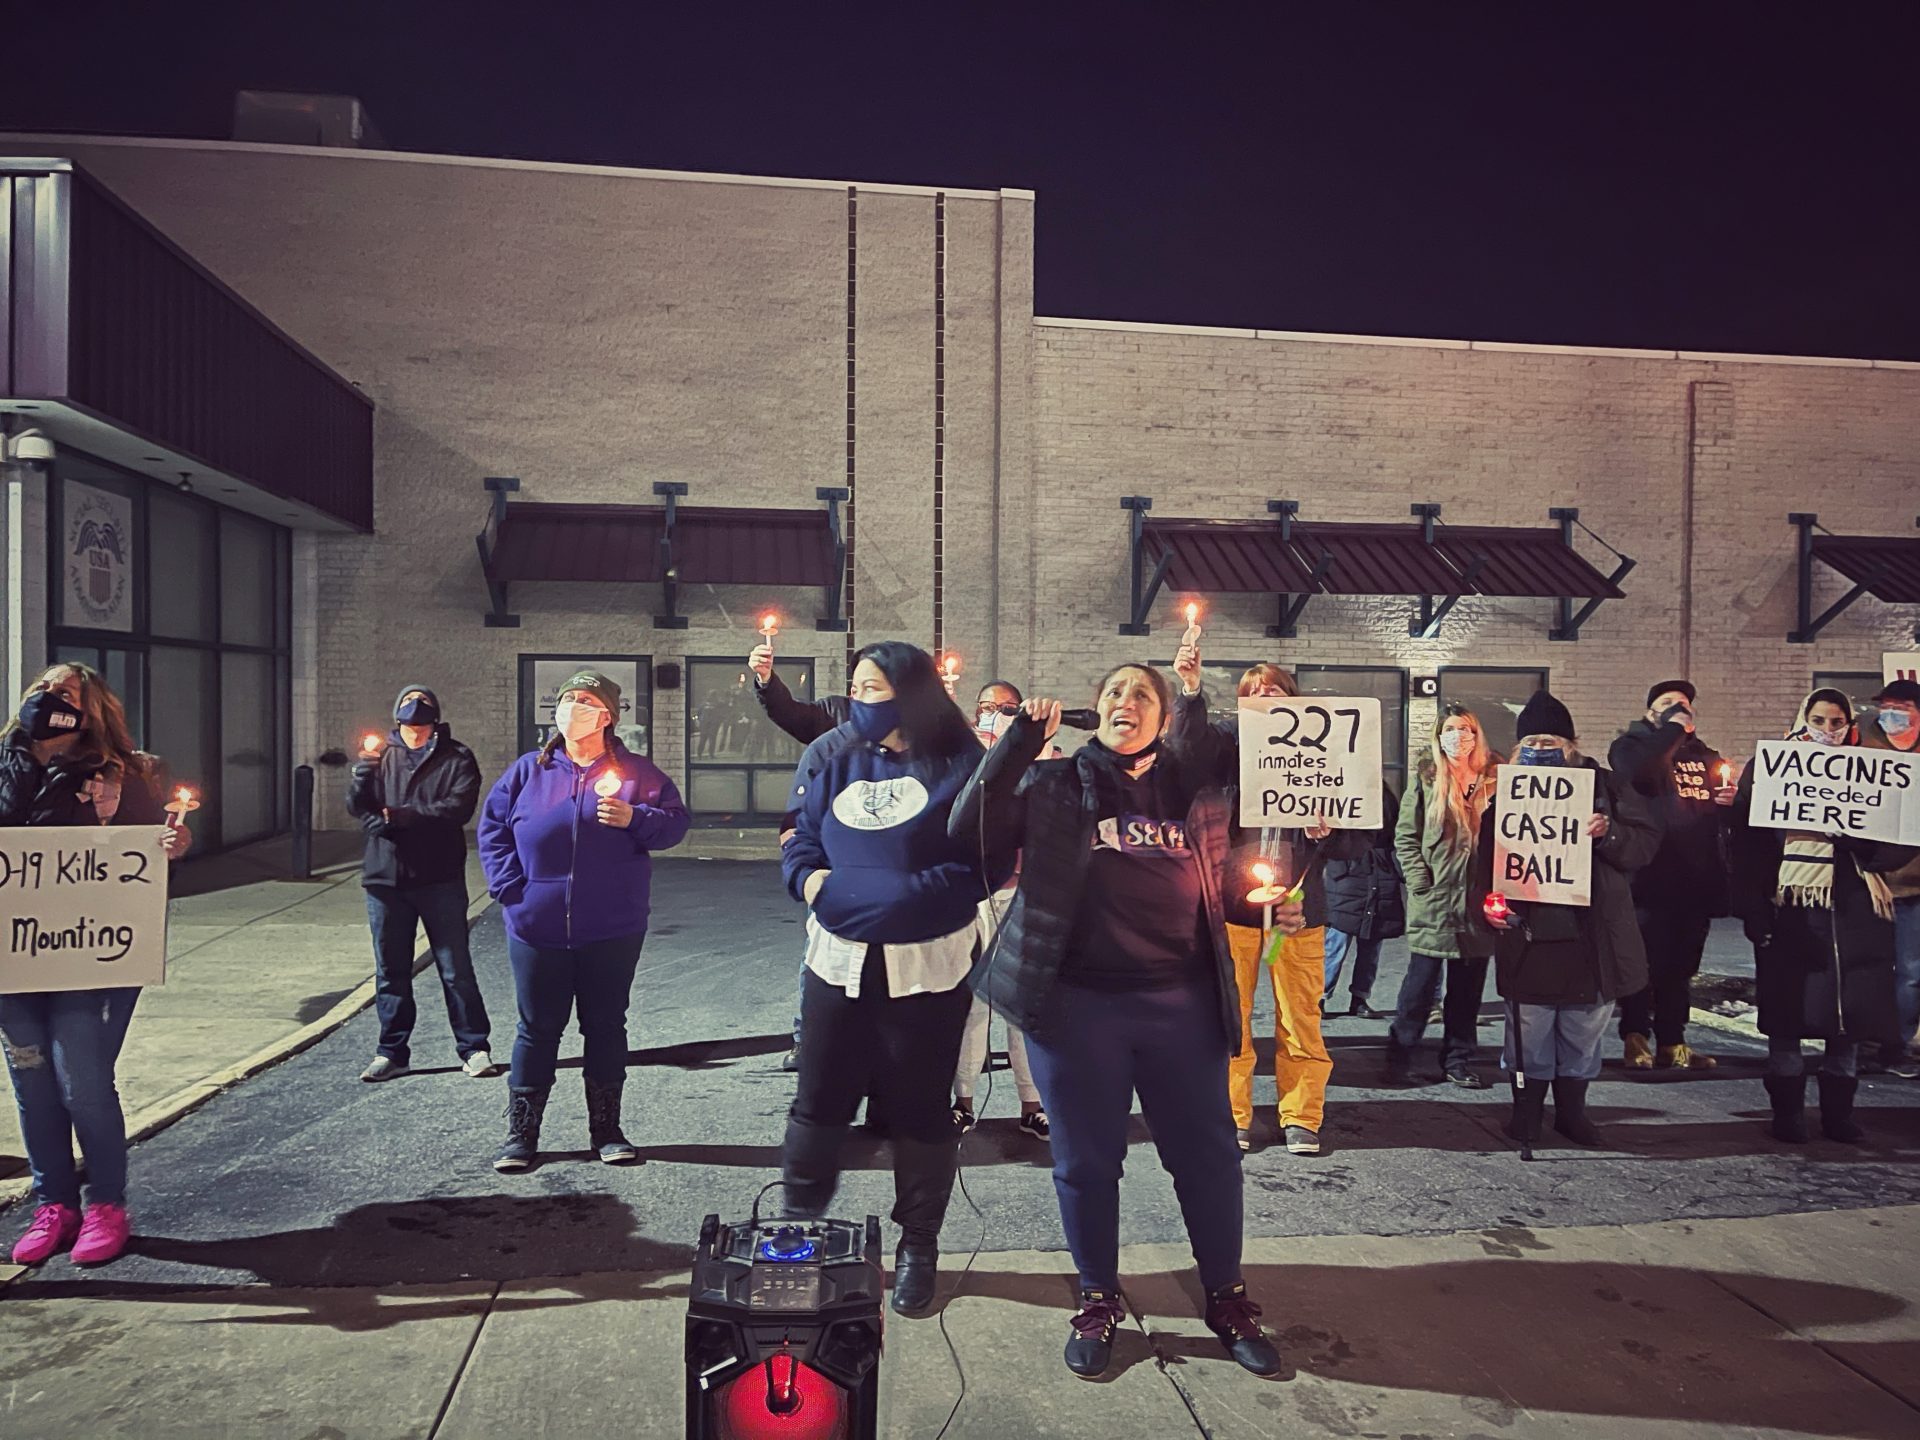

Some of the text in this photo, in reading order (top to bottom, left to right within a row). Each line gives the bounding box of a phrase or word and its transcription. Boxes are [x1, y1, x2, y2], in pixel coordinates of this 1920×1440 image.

[89, 549, 110, 569] USA
[1268, 705, 1361, 753] 227
[1258, 750, 1328, 769] inmates
[1761, 748, 1912, 789] VACCINES
[1282, 767, 1344, 788] tested
[1510, 774, 1574, 800] END
[1262, 789, 1363, 819] POSITIVE
[1783, 780, 1882, 807] needed
[1500, 812, 1579, 846] CASH
[1770, 799, 1867, 830] HERE
[55, 848, 109, 885] Kills
[118, 850, 151, 884] 2
[1504, 852, 1575, 885] BAIL
[11, 916, 134, 963] Mounting
